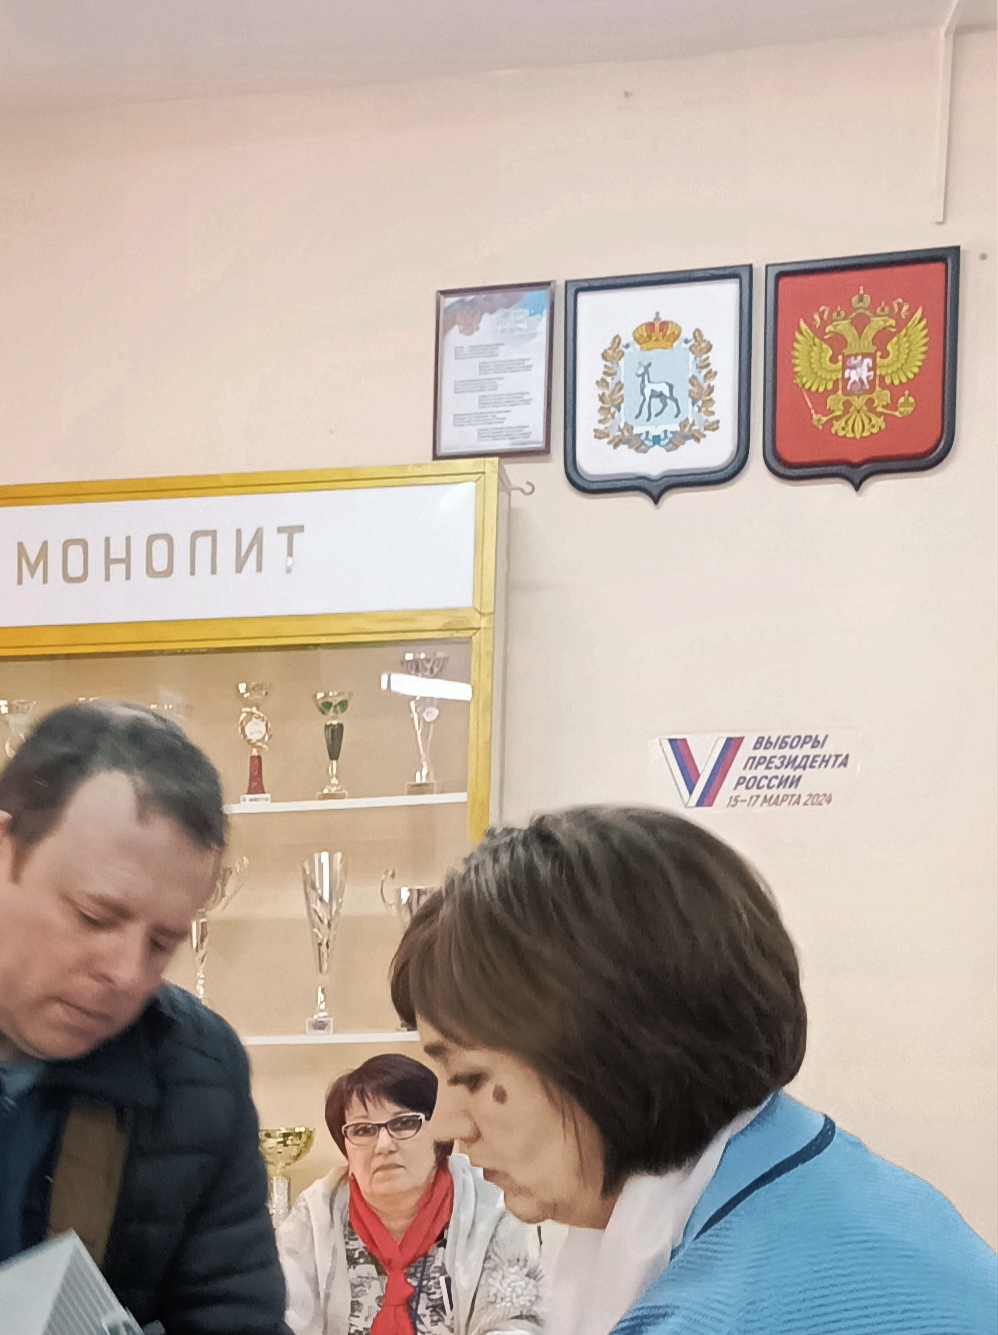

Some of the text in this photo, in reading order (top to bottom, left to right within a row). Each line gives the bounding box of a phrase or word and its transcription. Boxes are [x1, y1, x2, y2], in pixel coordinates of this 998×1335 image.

[752, 734, 829, 750] ВЫБОРЫ
[743, 754, 850, 771] ПРЕЗИДЕНТА
[733, 775, 802, 790] РОССИИ
[761, 793, 801, 807] МАРТА
[802, 793, 833, 806] 2024
